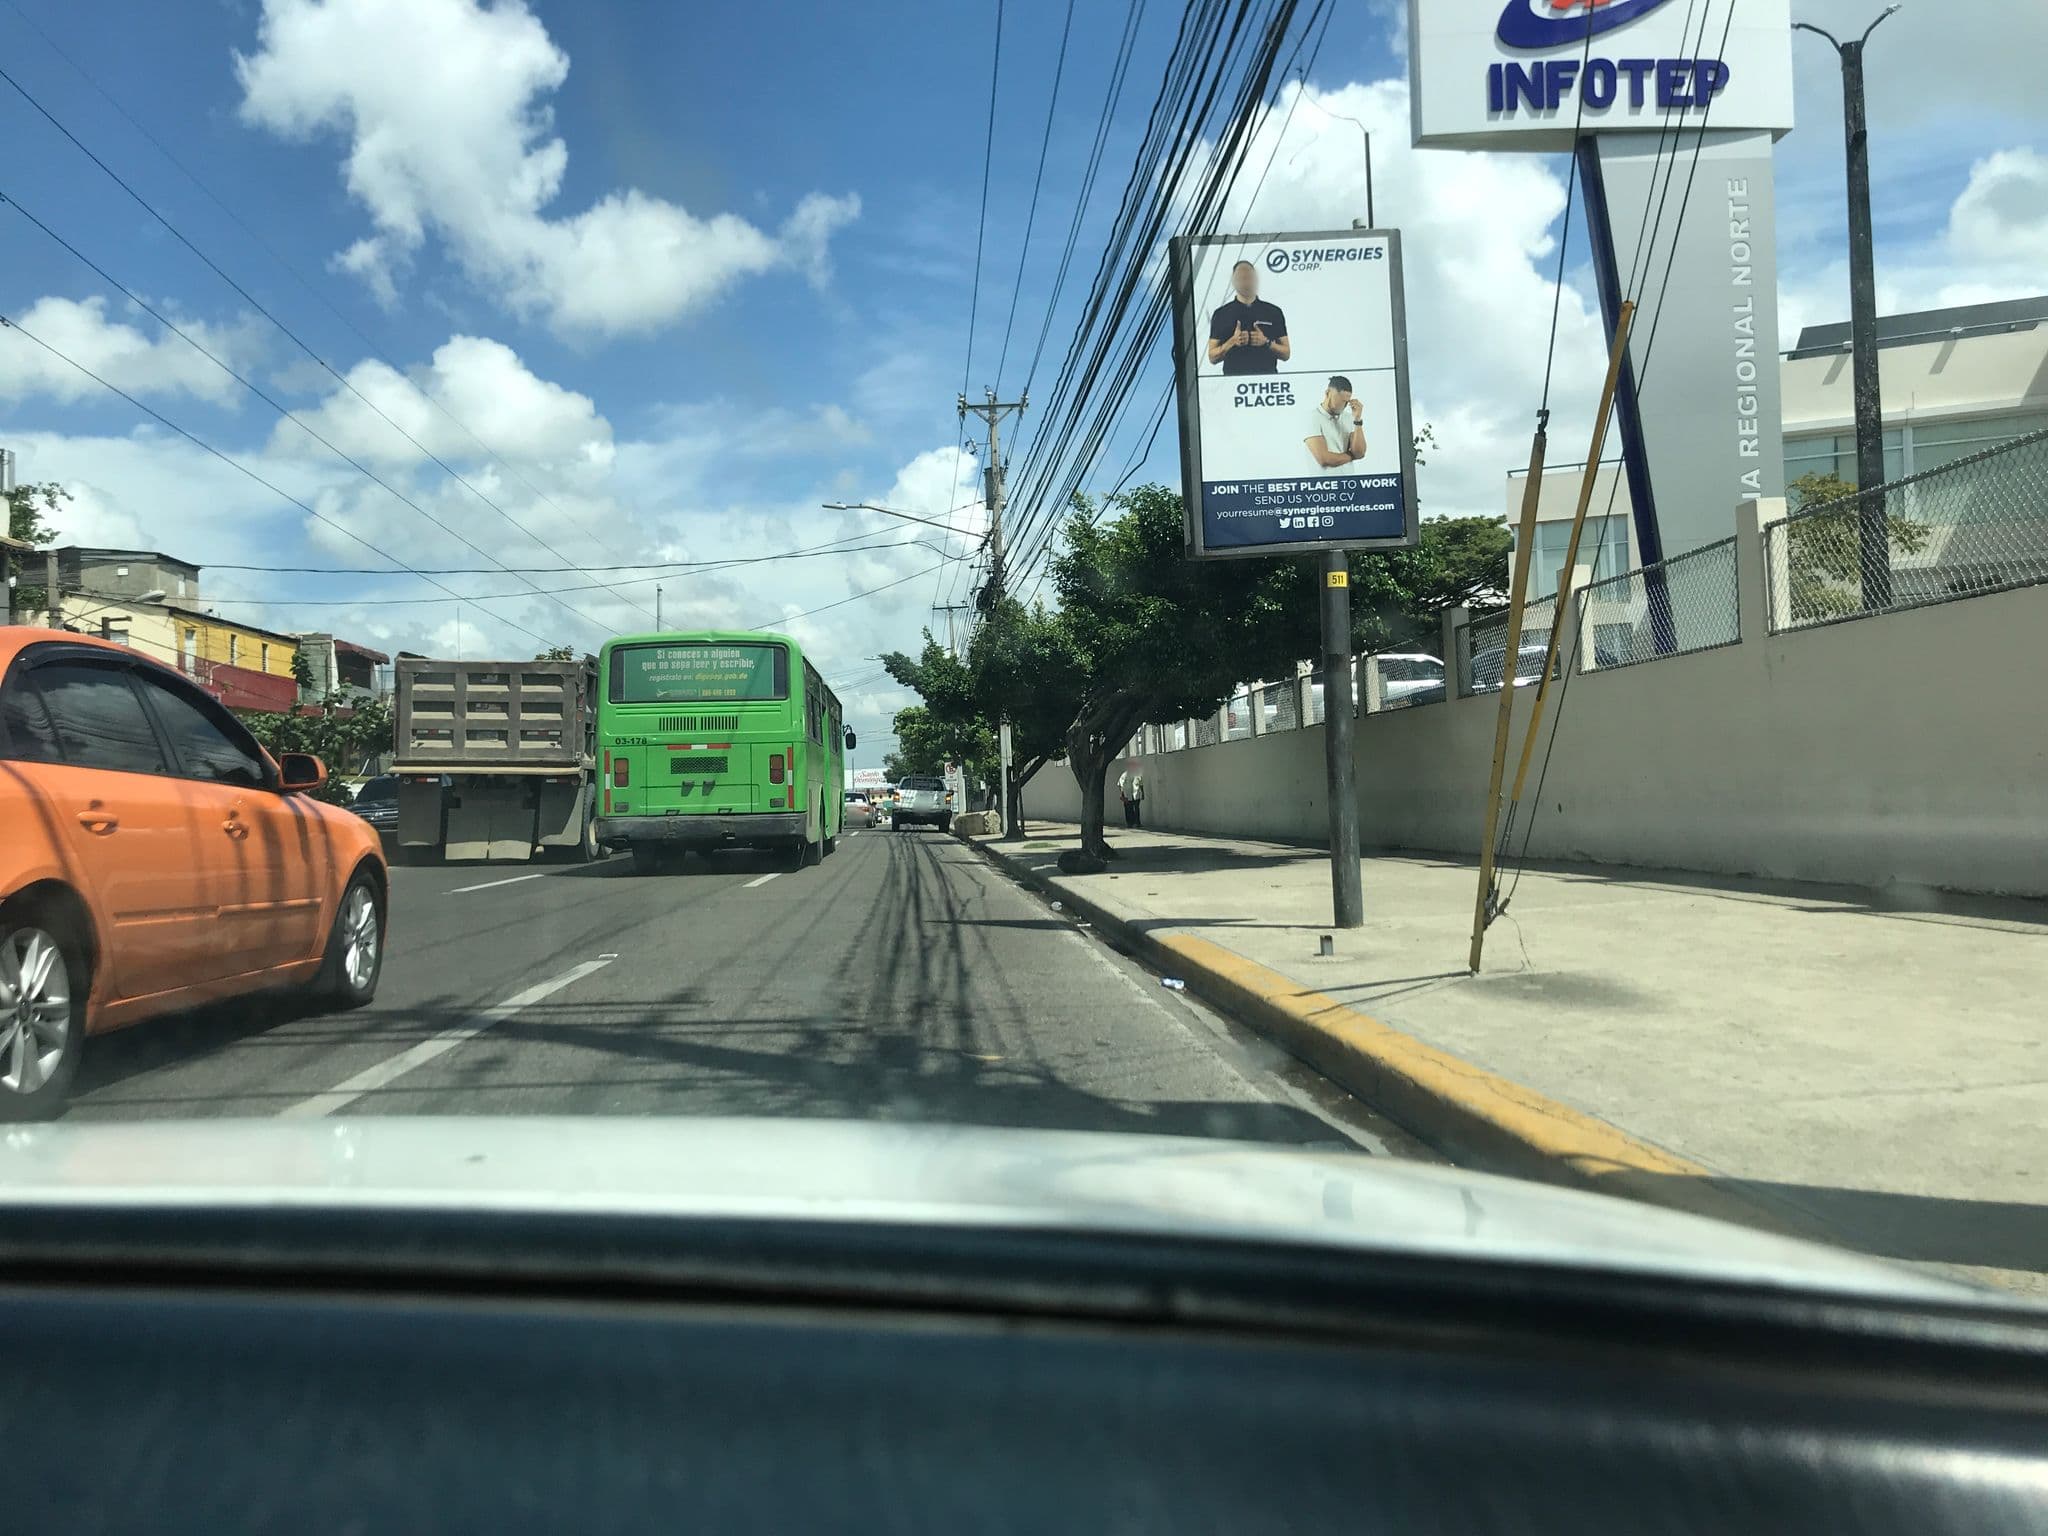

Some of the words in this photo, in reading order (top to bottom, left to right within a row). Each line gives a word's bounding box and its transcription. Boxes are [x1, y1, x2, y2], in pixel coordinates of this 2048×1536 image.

[1489, 58, 1730, 112] INFOTEP
[1728, 178, 1753, 286] NORTE
[1291, 247, 1383, 263] SYNERGIES
[1291, 262, 1322, 271] CORP.
[1733, 297, 1760, 457] REGIONAL
[1237, 382, 1291, 395] OTHER
[1234, 394, 1295, 408] PLACES
[1211, 485, 1239, 495] JOIN
[1242, 483, 1265, 494] THE
[1268, 482, 1298, 493] BEST
[1300, 481, 1338, 491] PLACE
[1340, 480, 1357, 490] TO
[1360, 478, 1397, 489] WORK
[1254, 495, 1285, 505] SEND
[1287, 494, 1303, 504] US
[1304, 493, 1337, 503] YOUR
[1339, 492, 1355, 502] CV
[1332, 574, 1344, 585] 511
[668, 650, 700, 659] conoces
[711, 649, 741, 660] alguien
[641, 661, 657, 671] que
[659, 660, 669, 670] no
